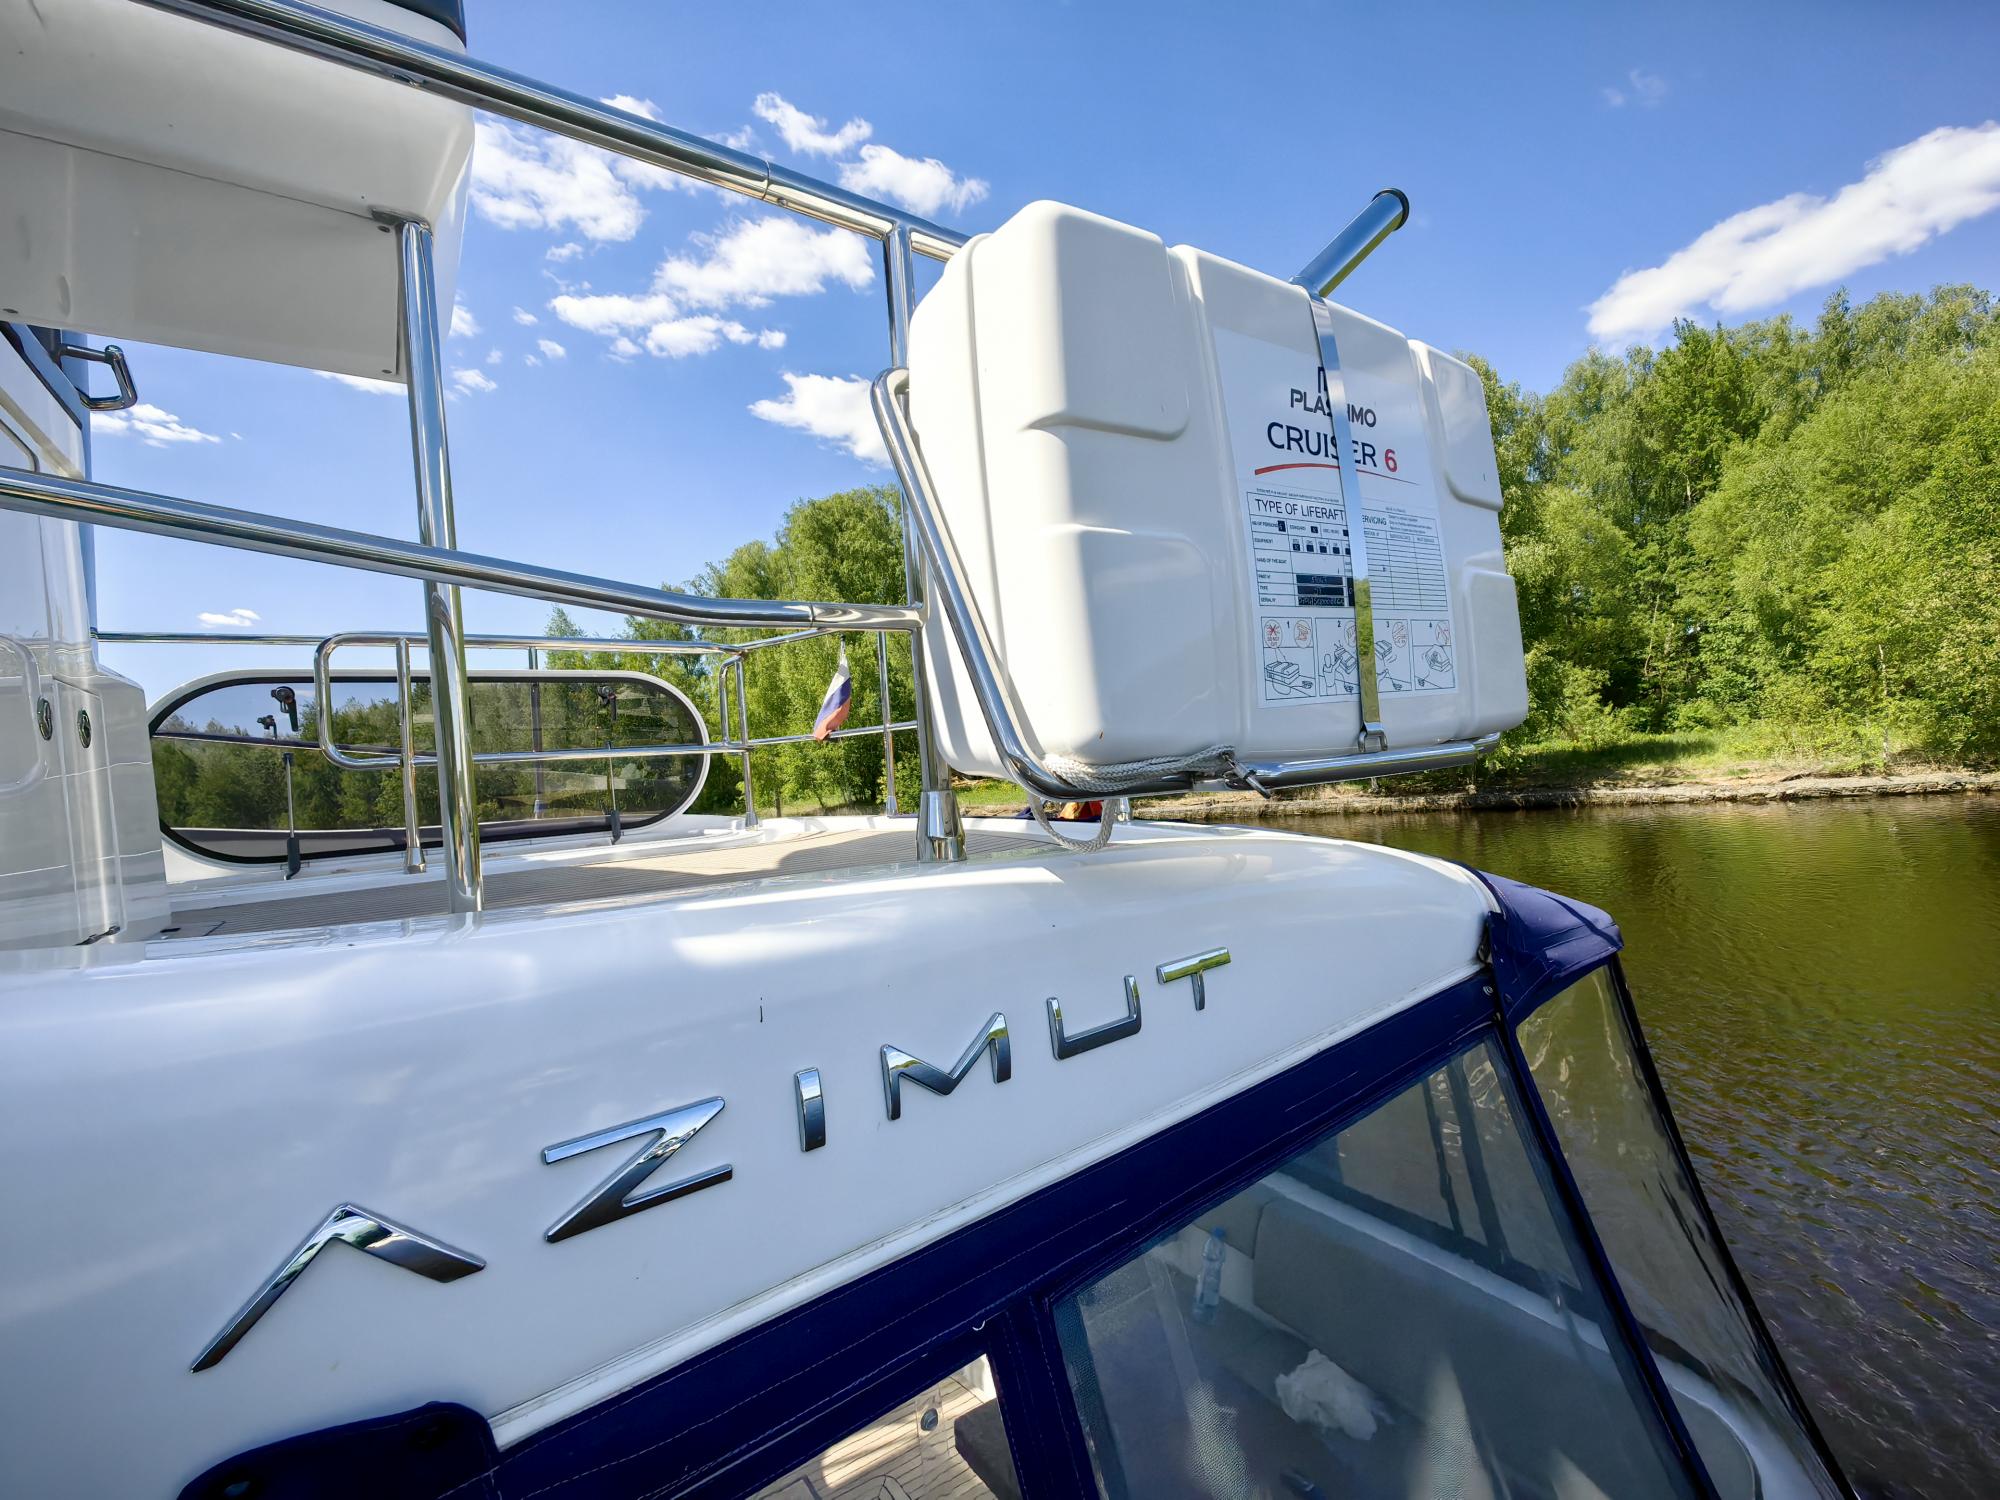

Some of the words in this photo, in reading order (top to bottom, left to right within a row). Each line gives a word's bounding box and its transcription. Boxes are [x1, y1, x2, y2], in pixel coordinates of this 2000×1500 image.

[1290, 388, 1377, 428] PLAIMO
[1384, 448, 1398, 473] 6
[1254, 498, 1283, 514] TYPE
[1284, 502, 1298, 515] OF
[1300, 504, 1345, 521] LIFERAFT
[1361, 513, 1387, 526] RVICING
[1286, 620, 1290, 629] 1
[1337, 620, 1342, 628] 2
[191, 947, 1230, 1374] AZIMUT
